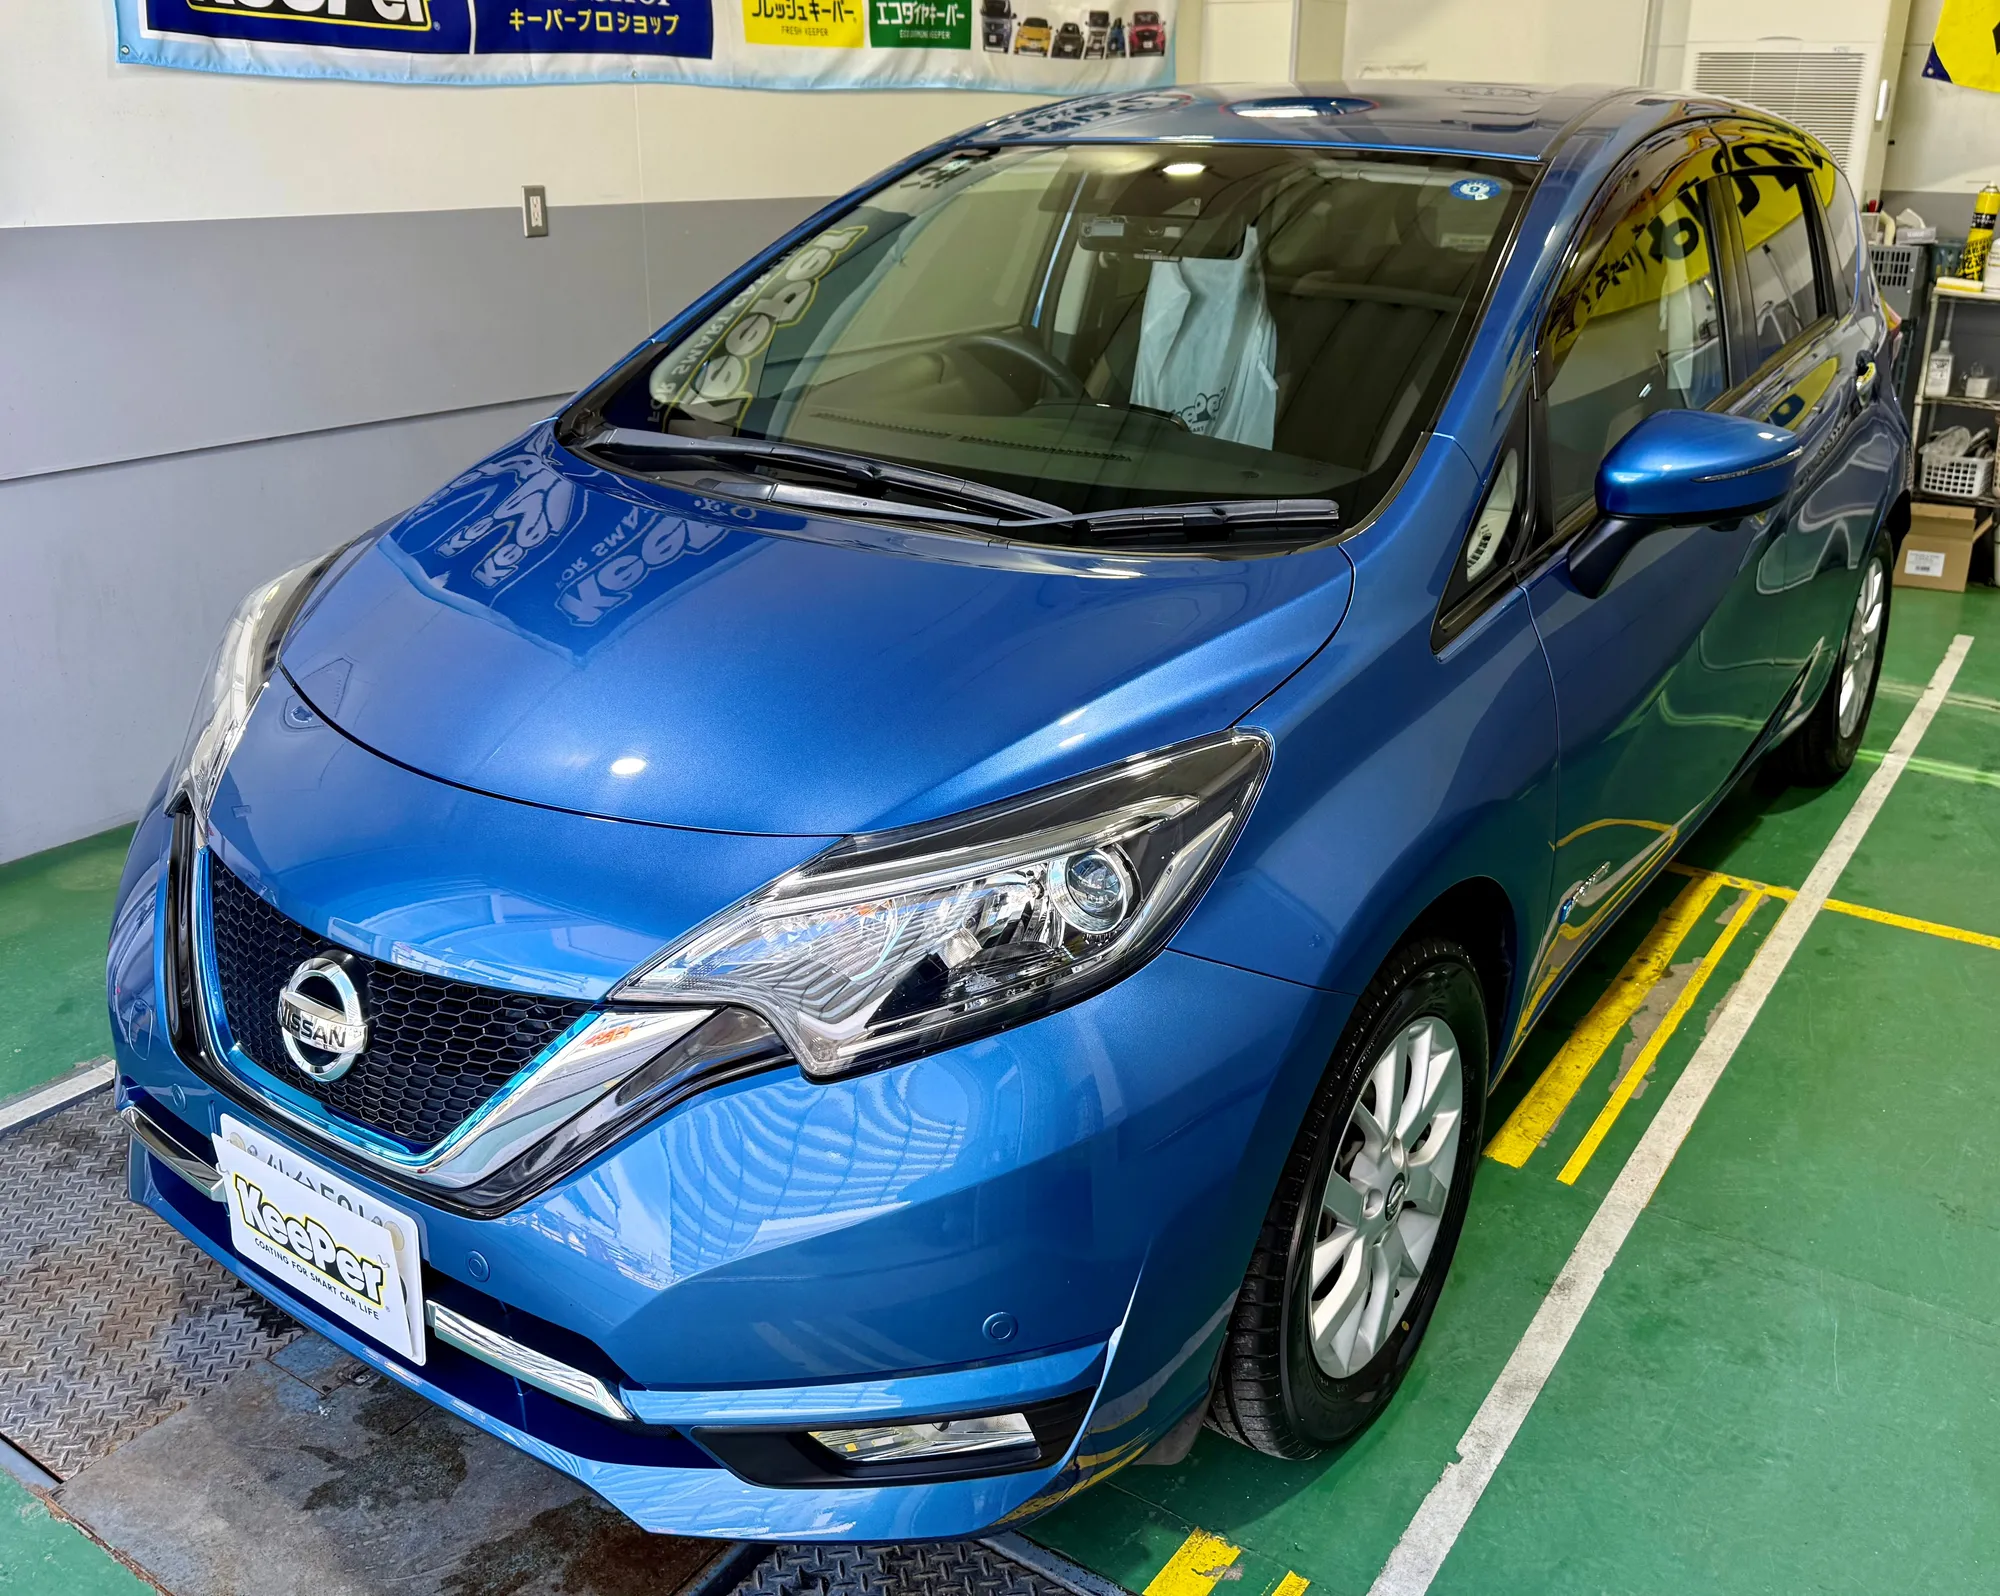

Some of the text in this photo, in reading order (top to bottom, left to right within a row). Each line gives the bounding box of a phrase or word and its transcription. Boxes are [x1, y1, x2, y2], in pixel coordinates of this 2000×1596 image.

[509, 8, 679, 35] キーパープロショップ
[876, 2, 965, 26] エコダイヤキーパー
[278, 997, 347, 1048] NISSAN
[235, 1174, 384, 1306] KeePer
[254, 1238, 380, 1320] COATING FOR SMART CAR LIFE
